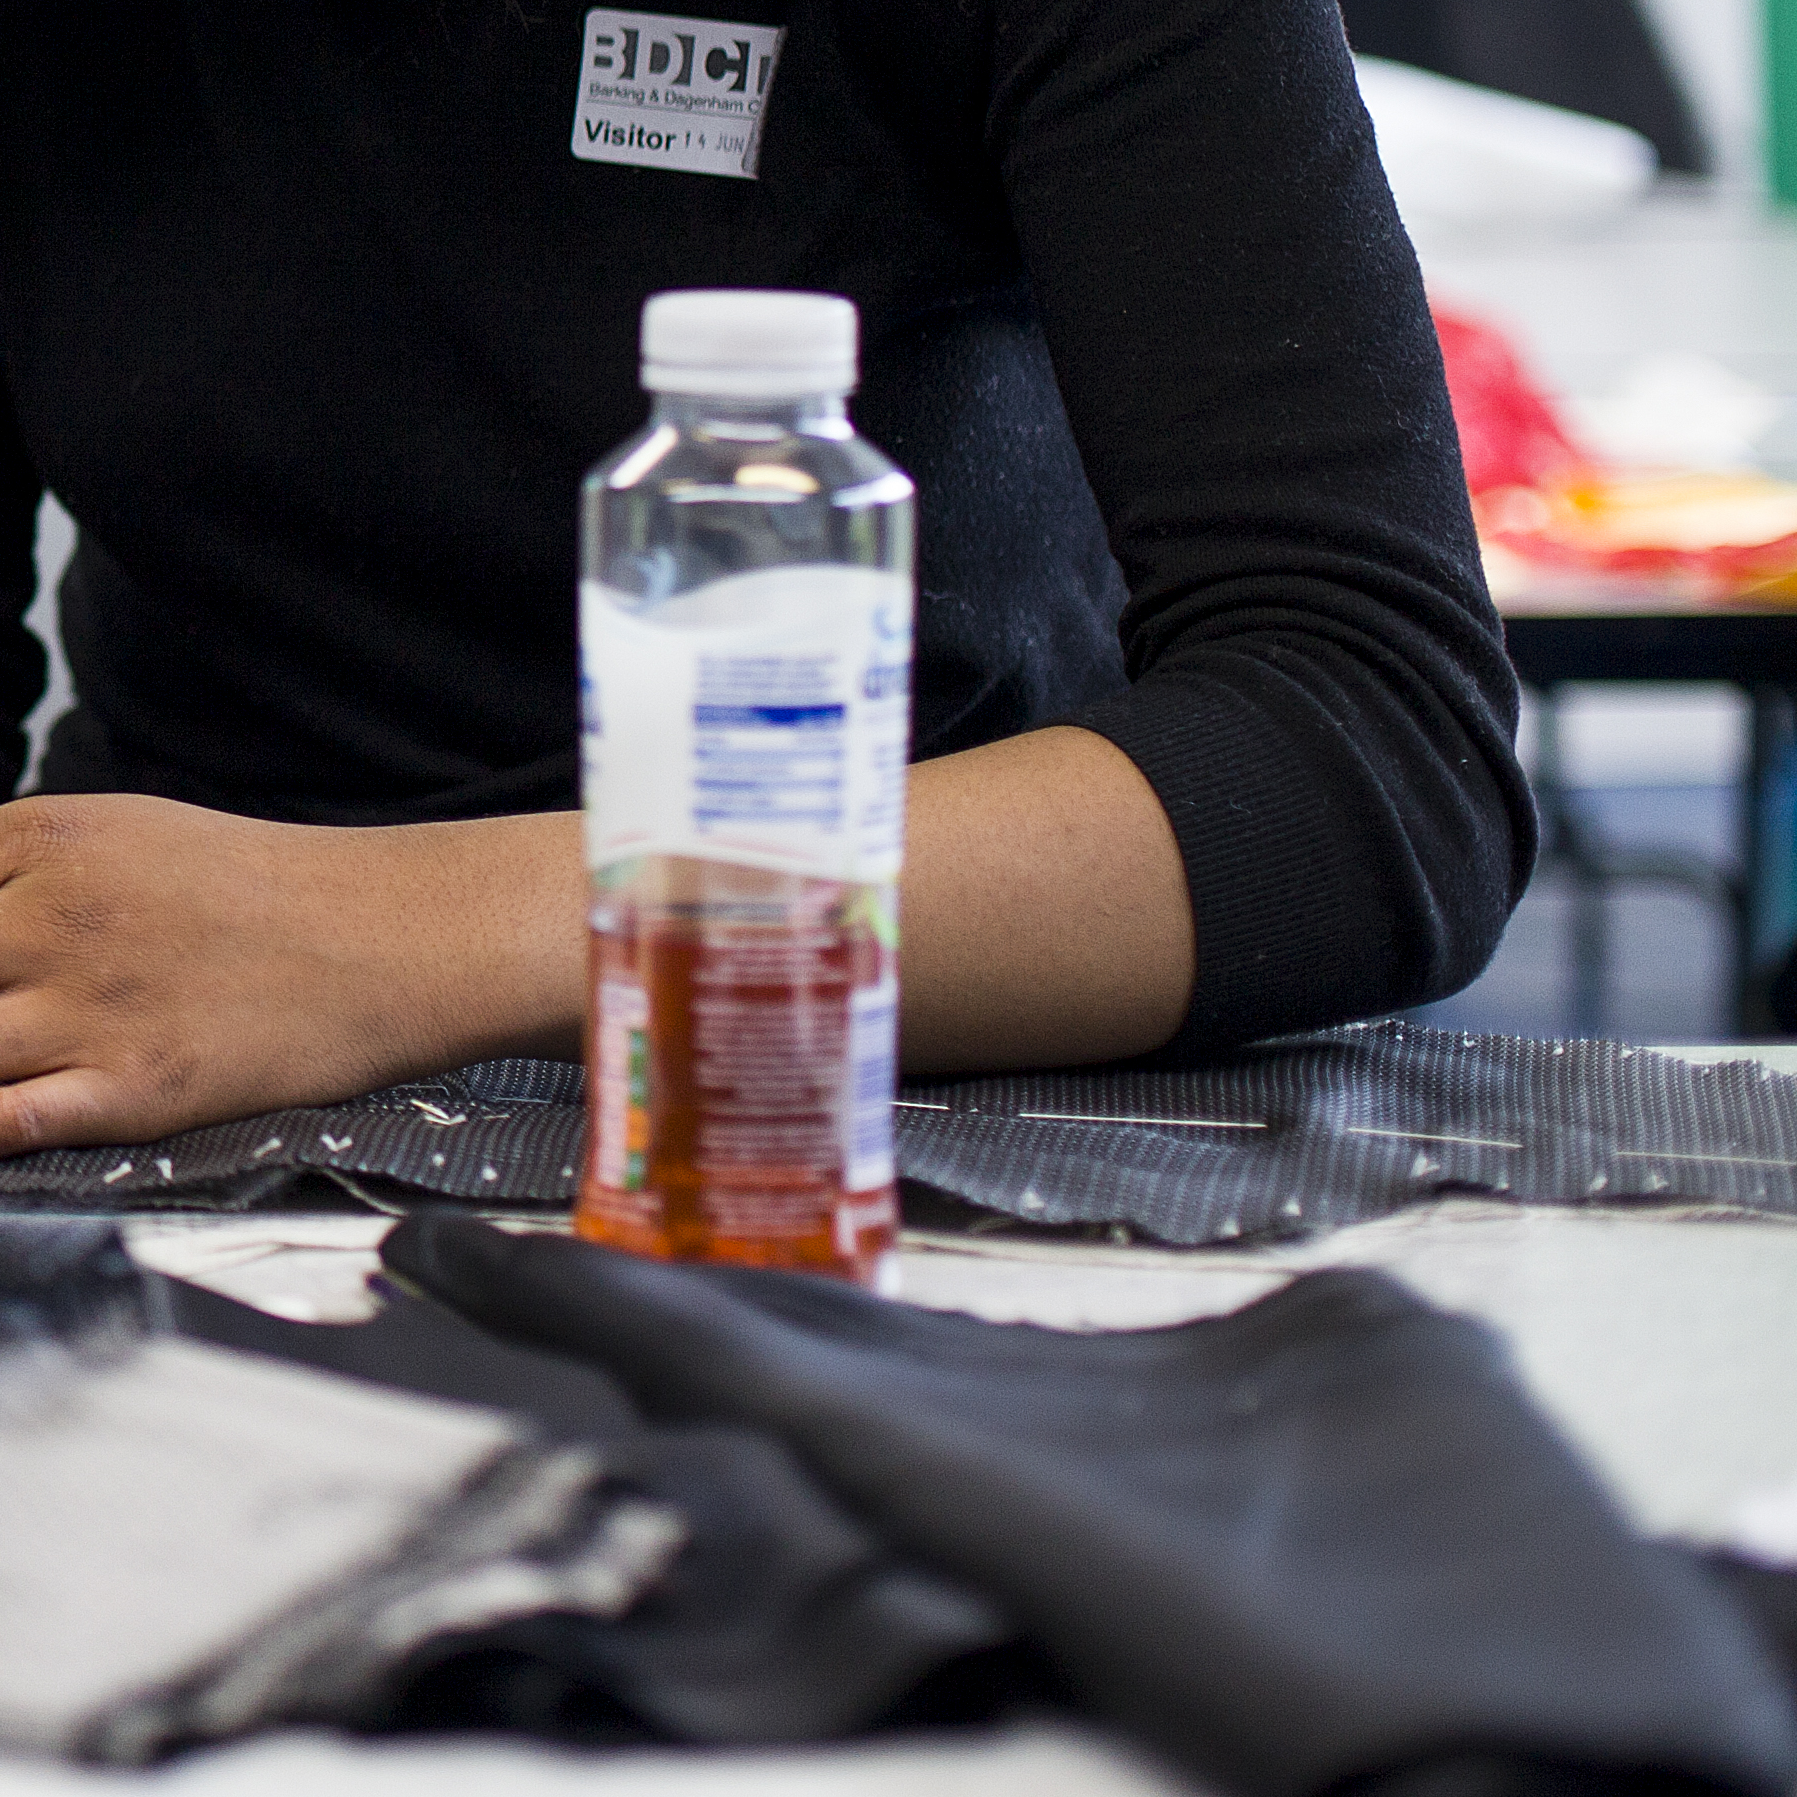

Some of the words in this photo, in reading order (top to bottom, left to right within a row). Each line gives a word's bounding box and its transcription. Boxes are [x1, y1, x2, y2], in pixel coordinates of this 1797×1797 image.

[589, 82, 645, 105] Barking
[649, 89, 659, 102] &
[664, 89, 744, 112] Dagenham
[584, 117, 677, 151] Visitor
[715, 133, 745, 153] JUN
